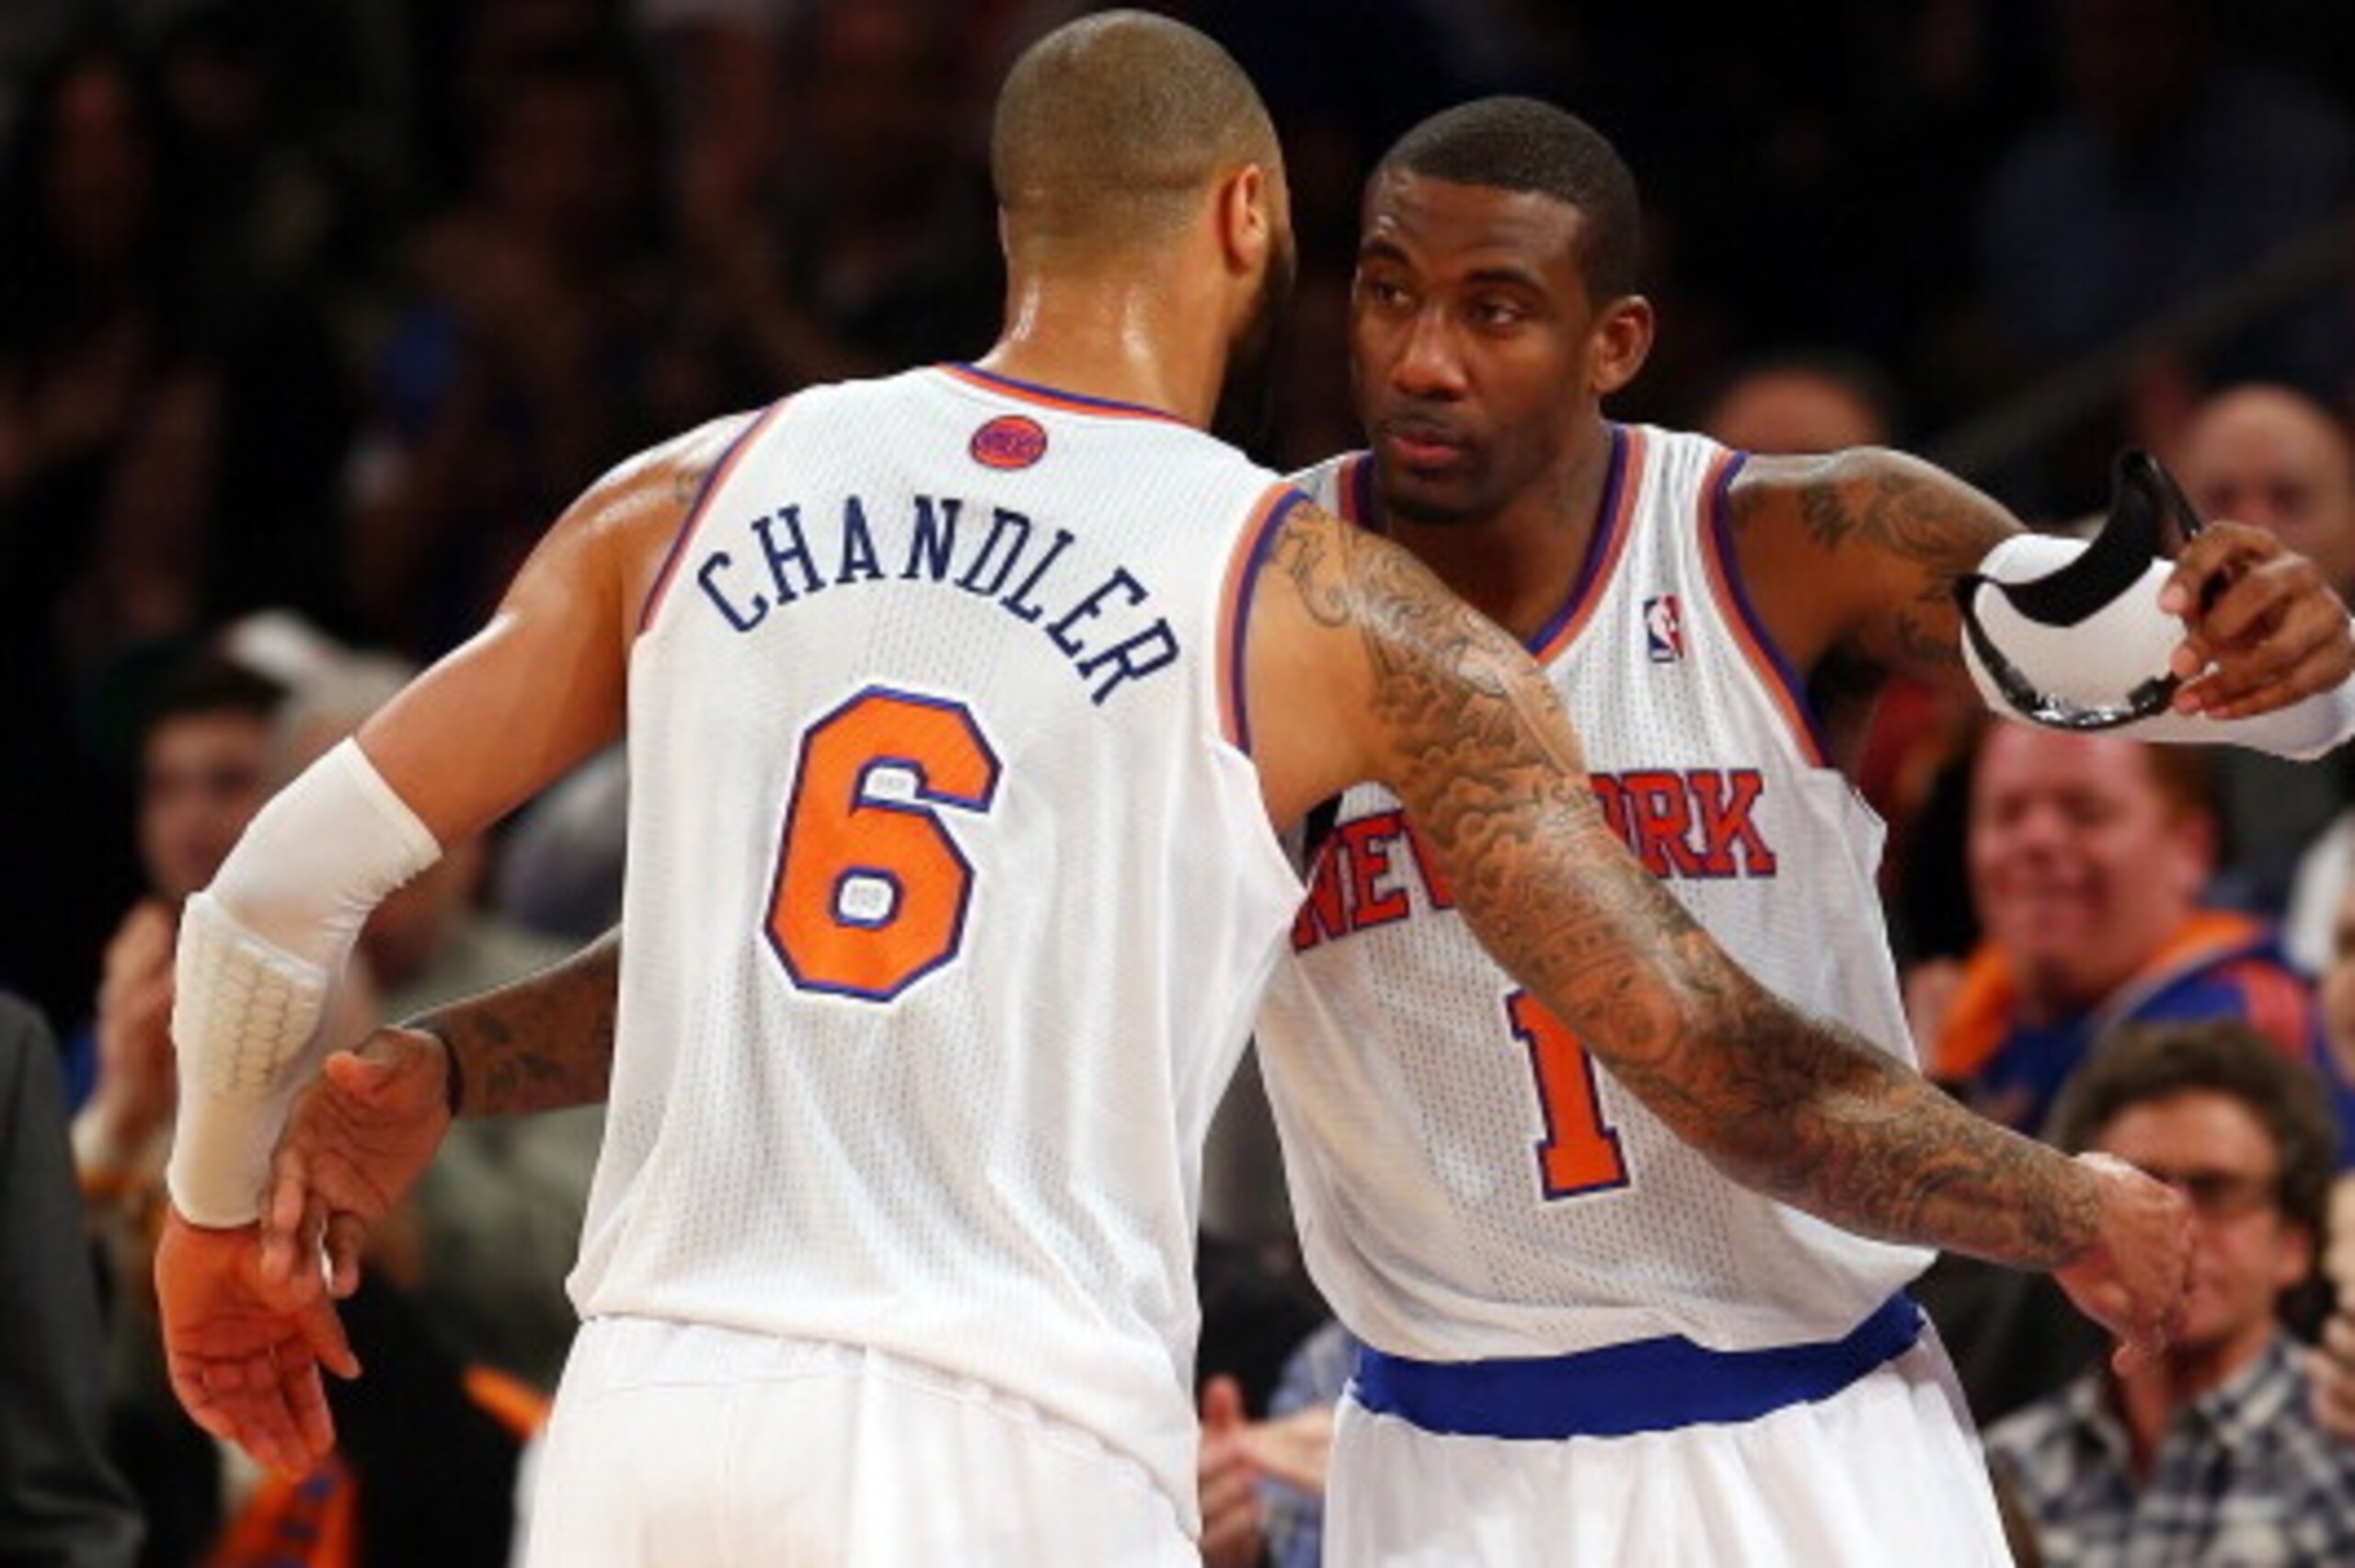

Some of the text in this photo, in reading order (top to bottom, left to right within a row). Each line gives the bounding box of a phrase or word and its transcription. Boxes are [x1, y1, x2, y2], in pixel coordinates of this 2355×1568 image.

[696, 495, 1180, 705] CHANDLER
[764, 685, 1003, 1003] 6
[1291, 807, 1455, 955] NE
[1506, 990, 1630, 1200] 1
